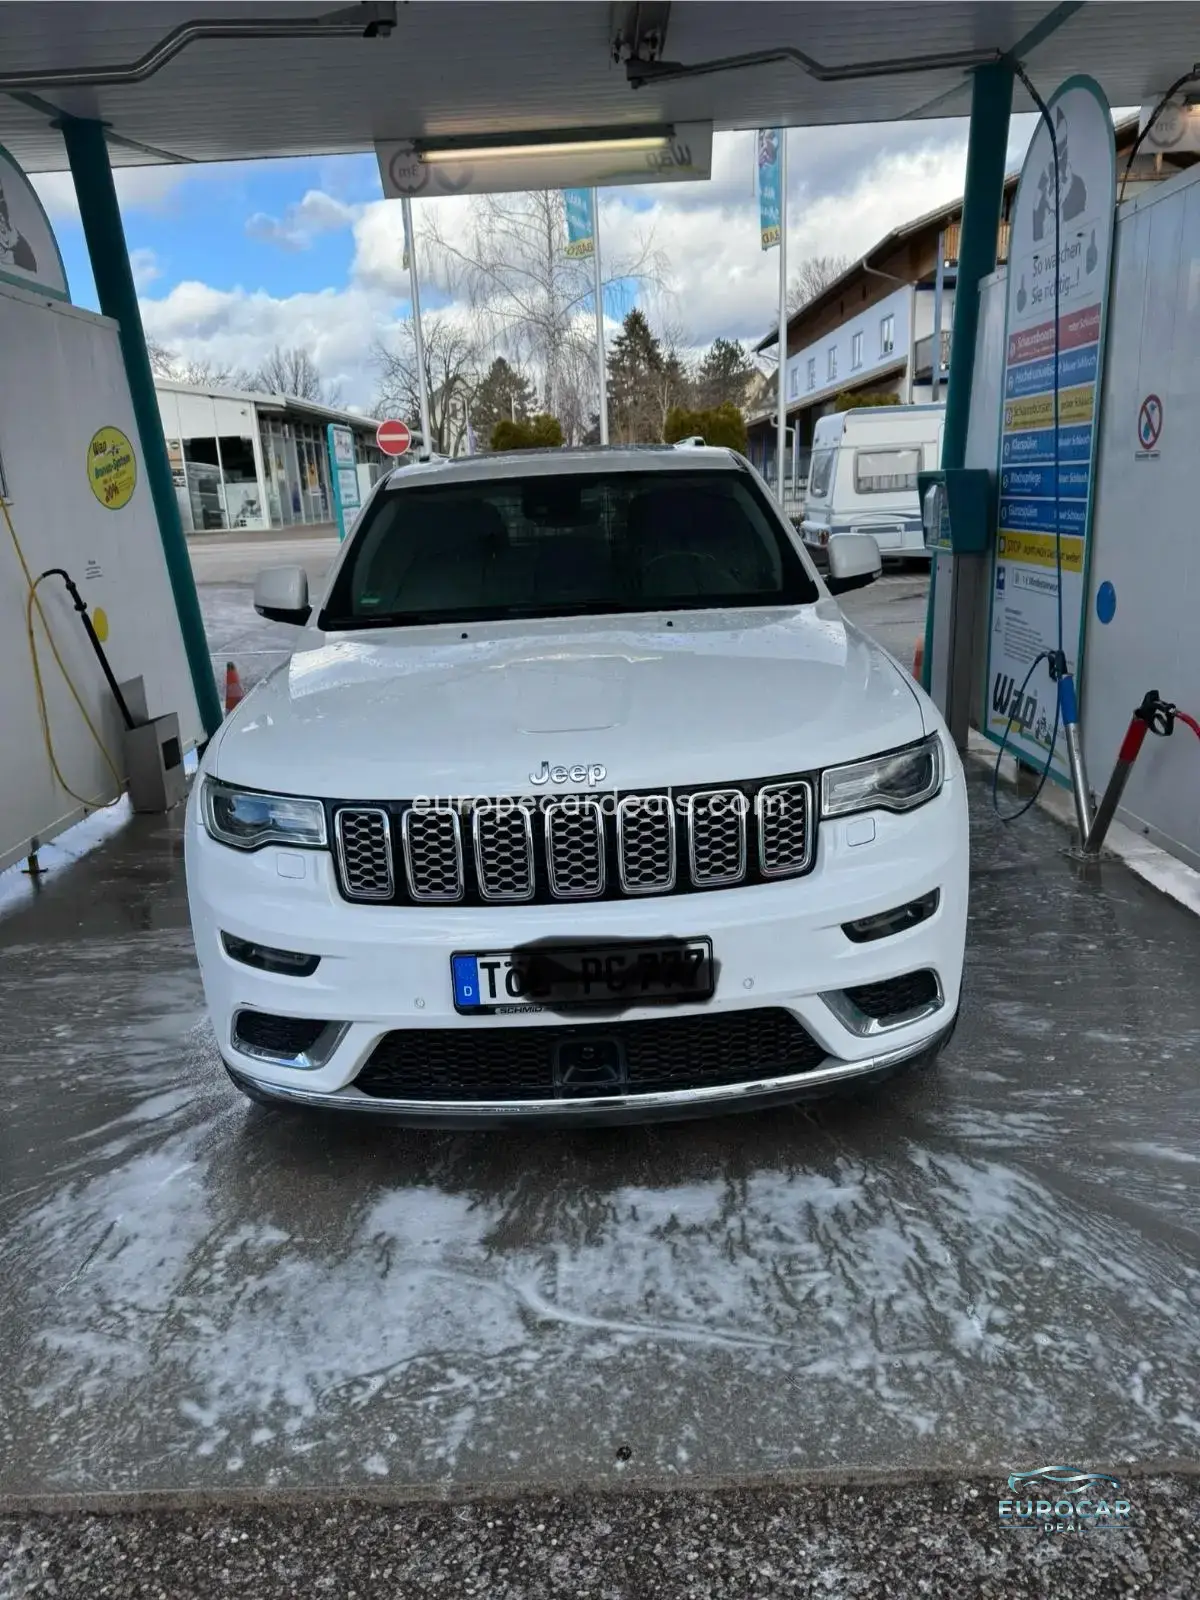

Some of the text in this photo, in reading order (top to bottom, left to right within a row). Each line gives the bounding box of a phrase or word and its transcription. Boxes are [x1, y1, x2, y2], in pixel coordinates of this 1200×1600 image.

[1033, 241, 1081, 277] So wachen
[993, 673, 1037, 730] Wap
[529, 761, 607, 787] Jeep
[464, 985, 472, 996] D
